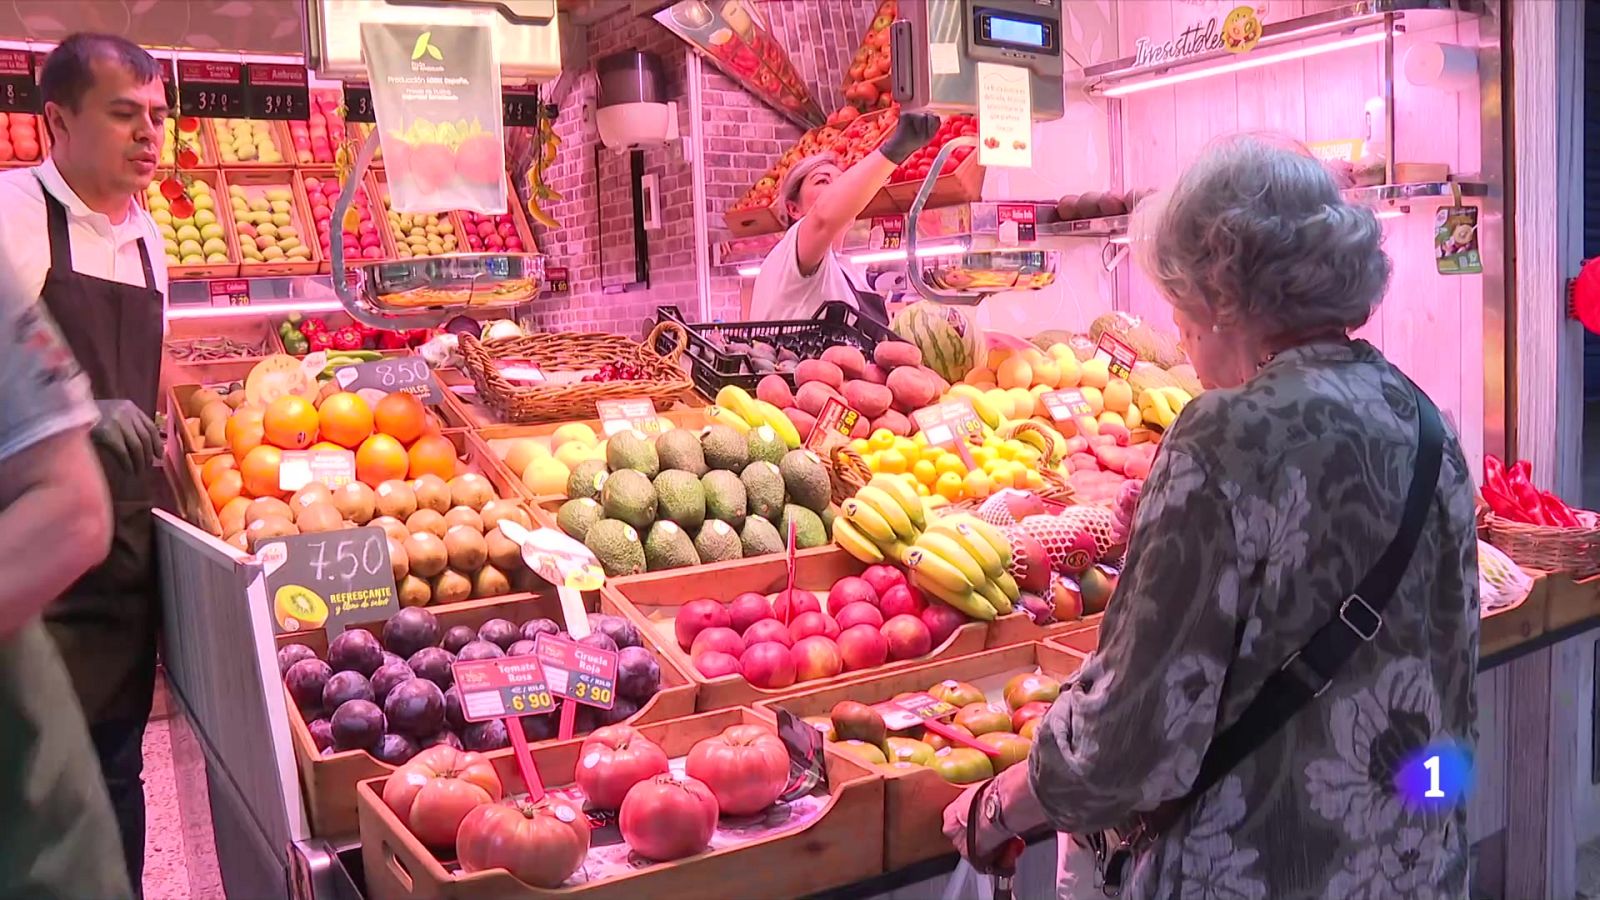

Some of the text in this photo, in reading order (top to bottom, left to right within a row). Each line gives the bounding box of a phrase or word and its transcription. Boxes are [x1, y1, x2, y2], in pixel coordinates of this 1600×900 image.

[307, 534, 384, 581] 7.50
[330, 587, 391, 603] REFRESCANTE
[574, 648, 608, 667] Ciruela
[499, 663, 536, 673] Tomate
[579, 660, 601, 675] Roja
[508, 671, 533, 682] Rosa
[575, 682, 610, 703] 3'90
[512, 692, 550, 711] 6'90
